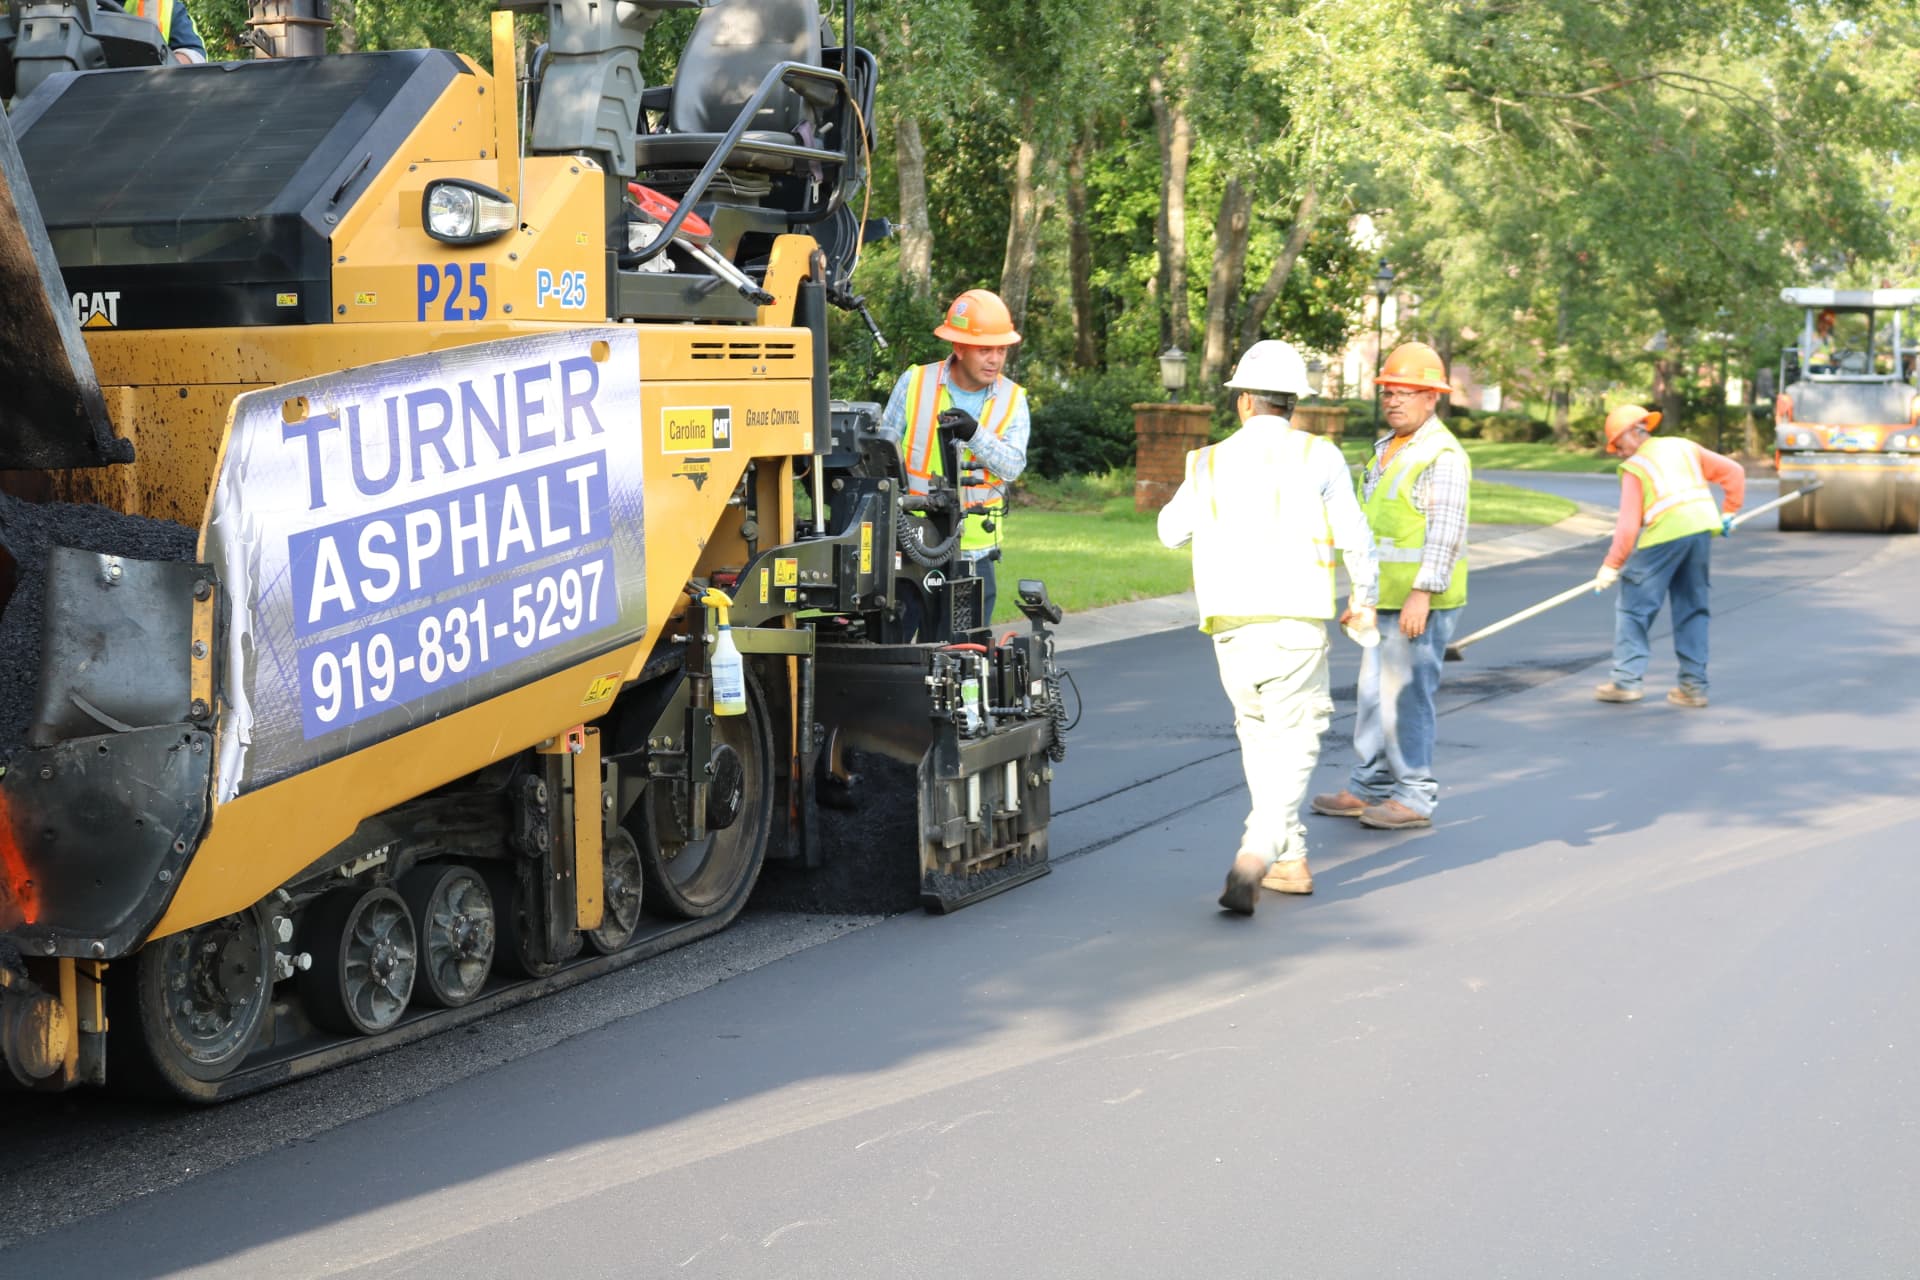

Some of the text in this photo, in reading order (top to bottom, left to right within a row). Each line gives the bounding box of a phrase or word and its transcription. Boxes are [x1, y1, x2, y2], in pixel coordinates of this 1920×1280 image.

[417, 263, 488, 322] P25
[537, 269, 587, 308] P-25
[72, 291, 121, 328] CAT
[281, 355, 605, 511] TURNER
[669, 420, 706, 440] Carolina
[713, 418, 730, 439] CAT
[745, 408, 800, 427] GRADE CONTROL
[308, 461, 599, 624] ASPHALT
[311, 559, 604, 723] 919-831-5297
